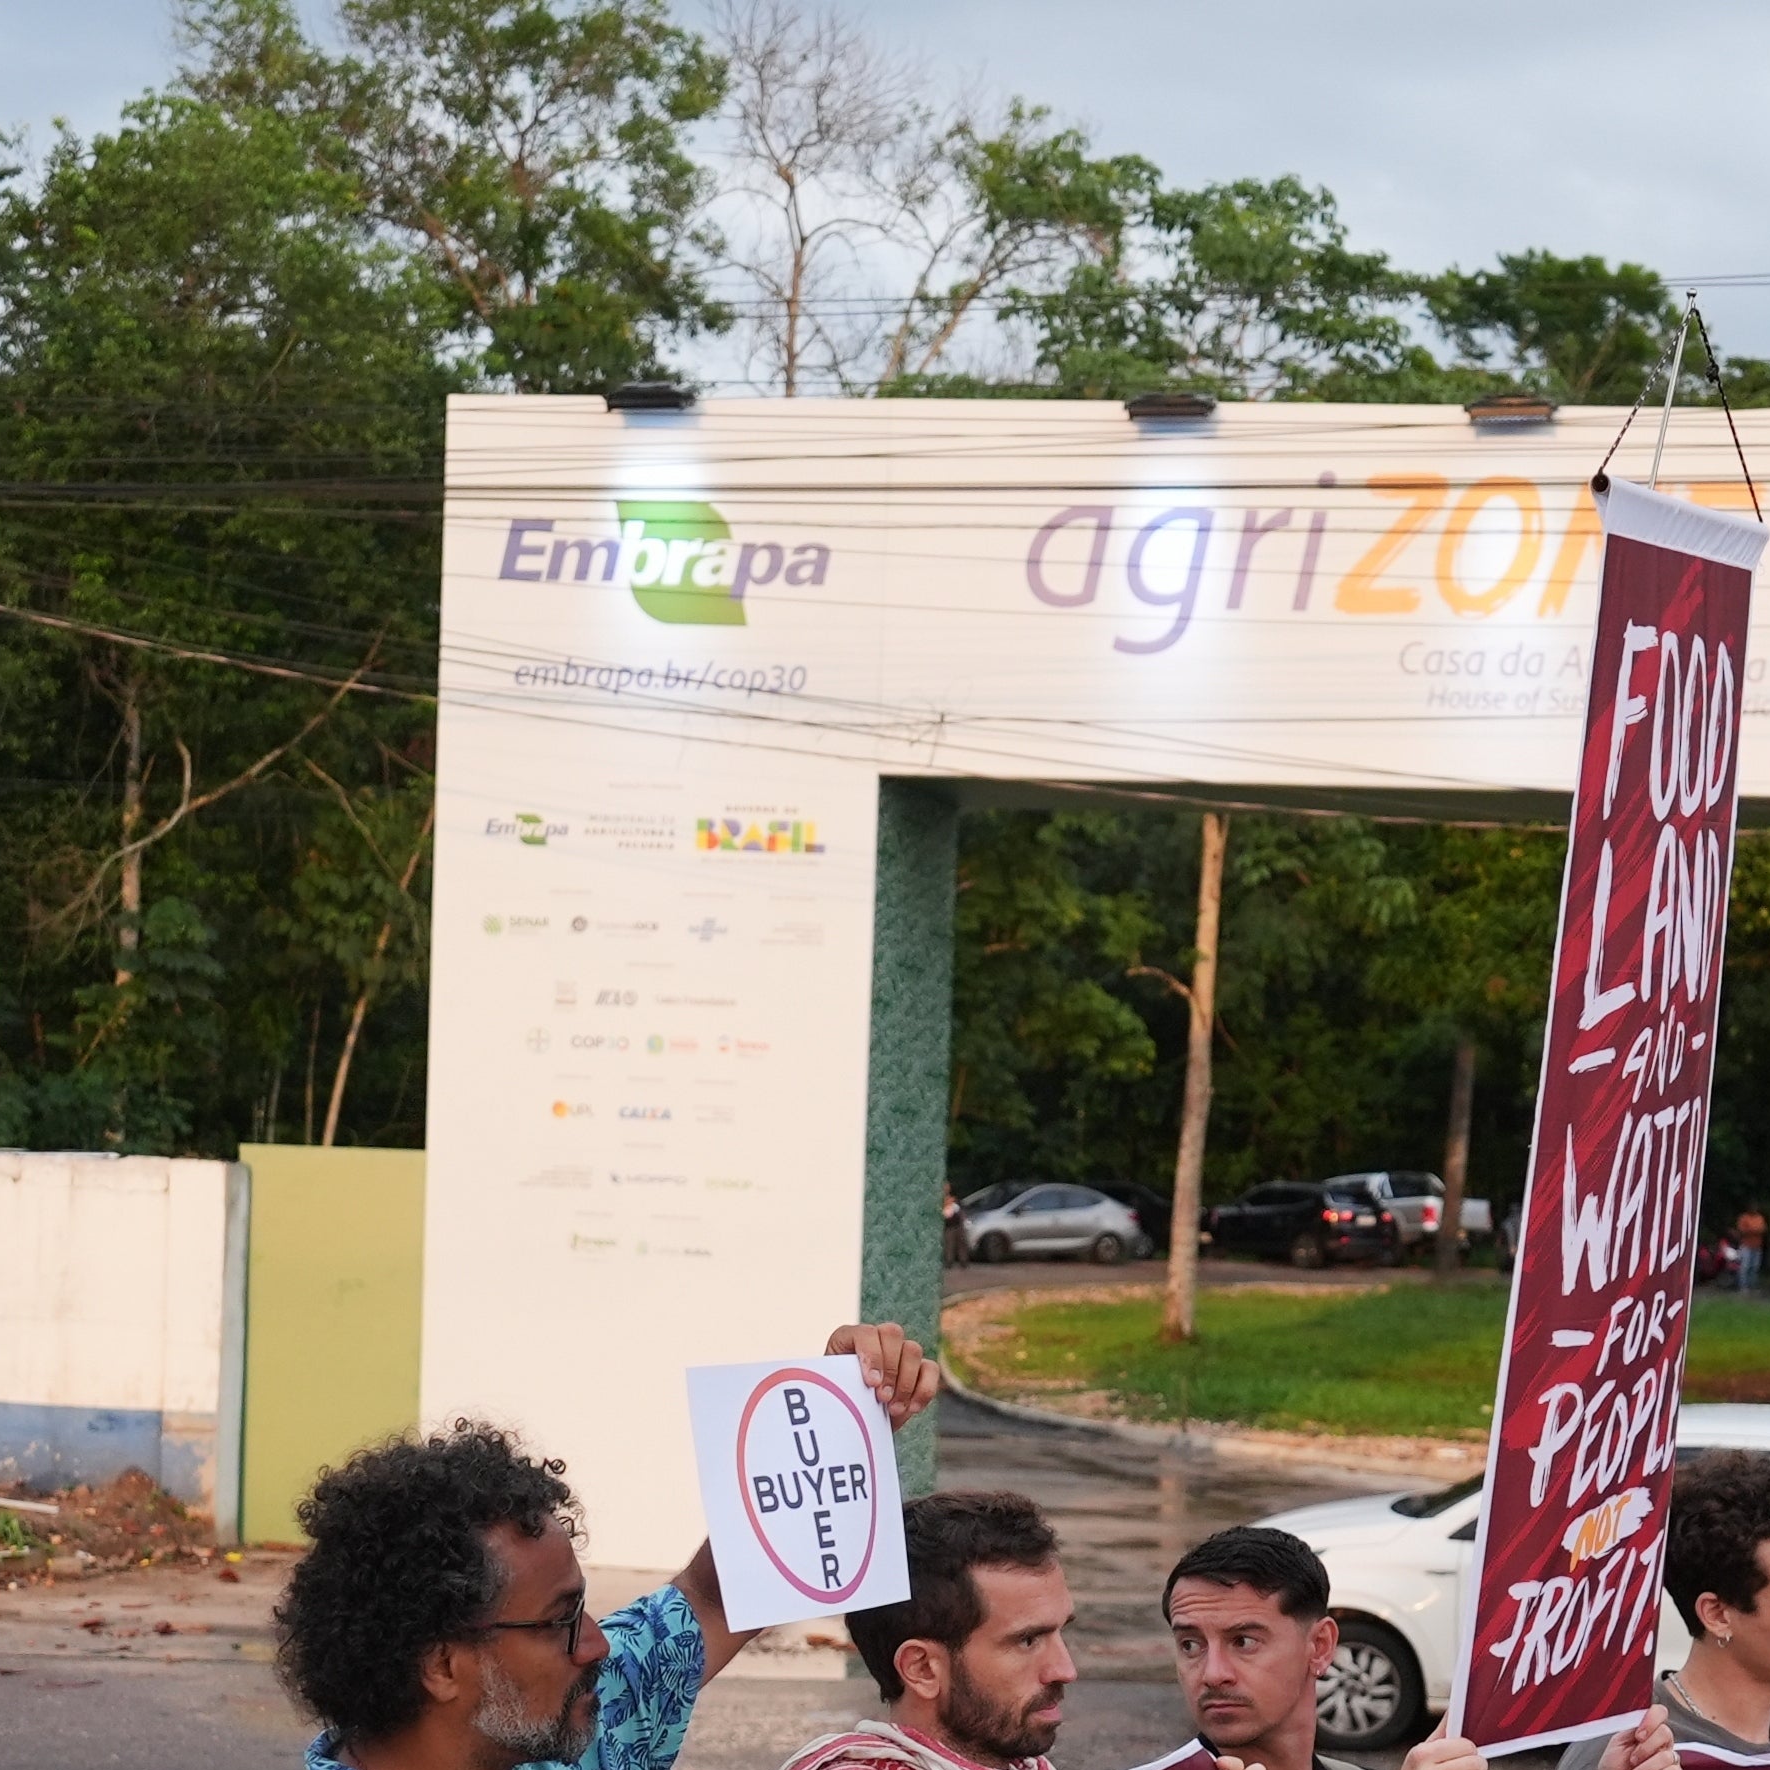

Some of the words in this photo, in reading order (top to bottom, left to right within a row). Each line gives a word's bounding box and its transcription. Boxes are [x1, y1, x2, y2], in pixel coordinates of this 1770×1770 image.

[498, 518, 831, 599] Embrapa
[514, 656, 808, 699] embrapa.br/cop30
[1399, 641, 1485, 676] Casa
[1499, 641, 1544, 677] da
[1603, 618, 1735, 822] FOOD
[696, 818, 826, 853] BRASIL
[1578, 823, 1720, 1031] LAND
[1561, 1096, 1703, 1297] WATER
[752, 1463, 868, 1514] BUYER
[1569, 1494, 1632, 1573] NOT
